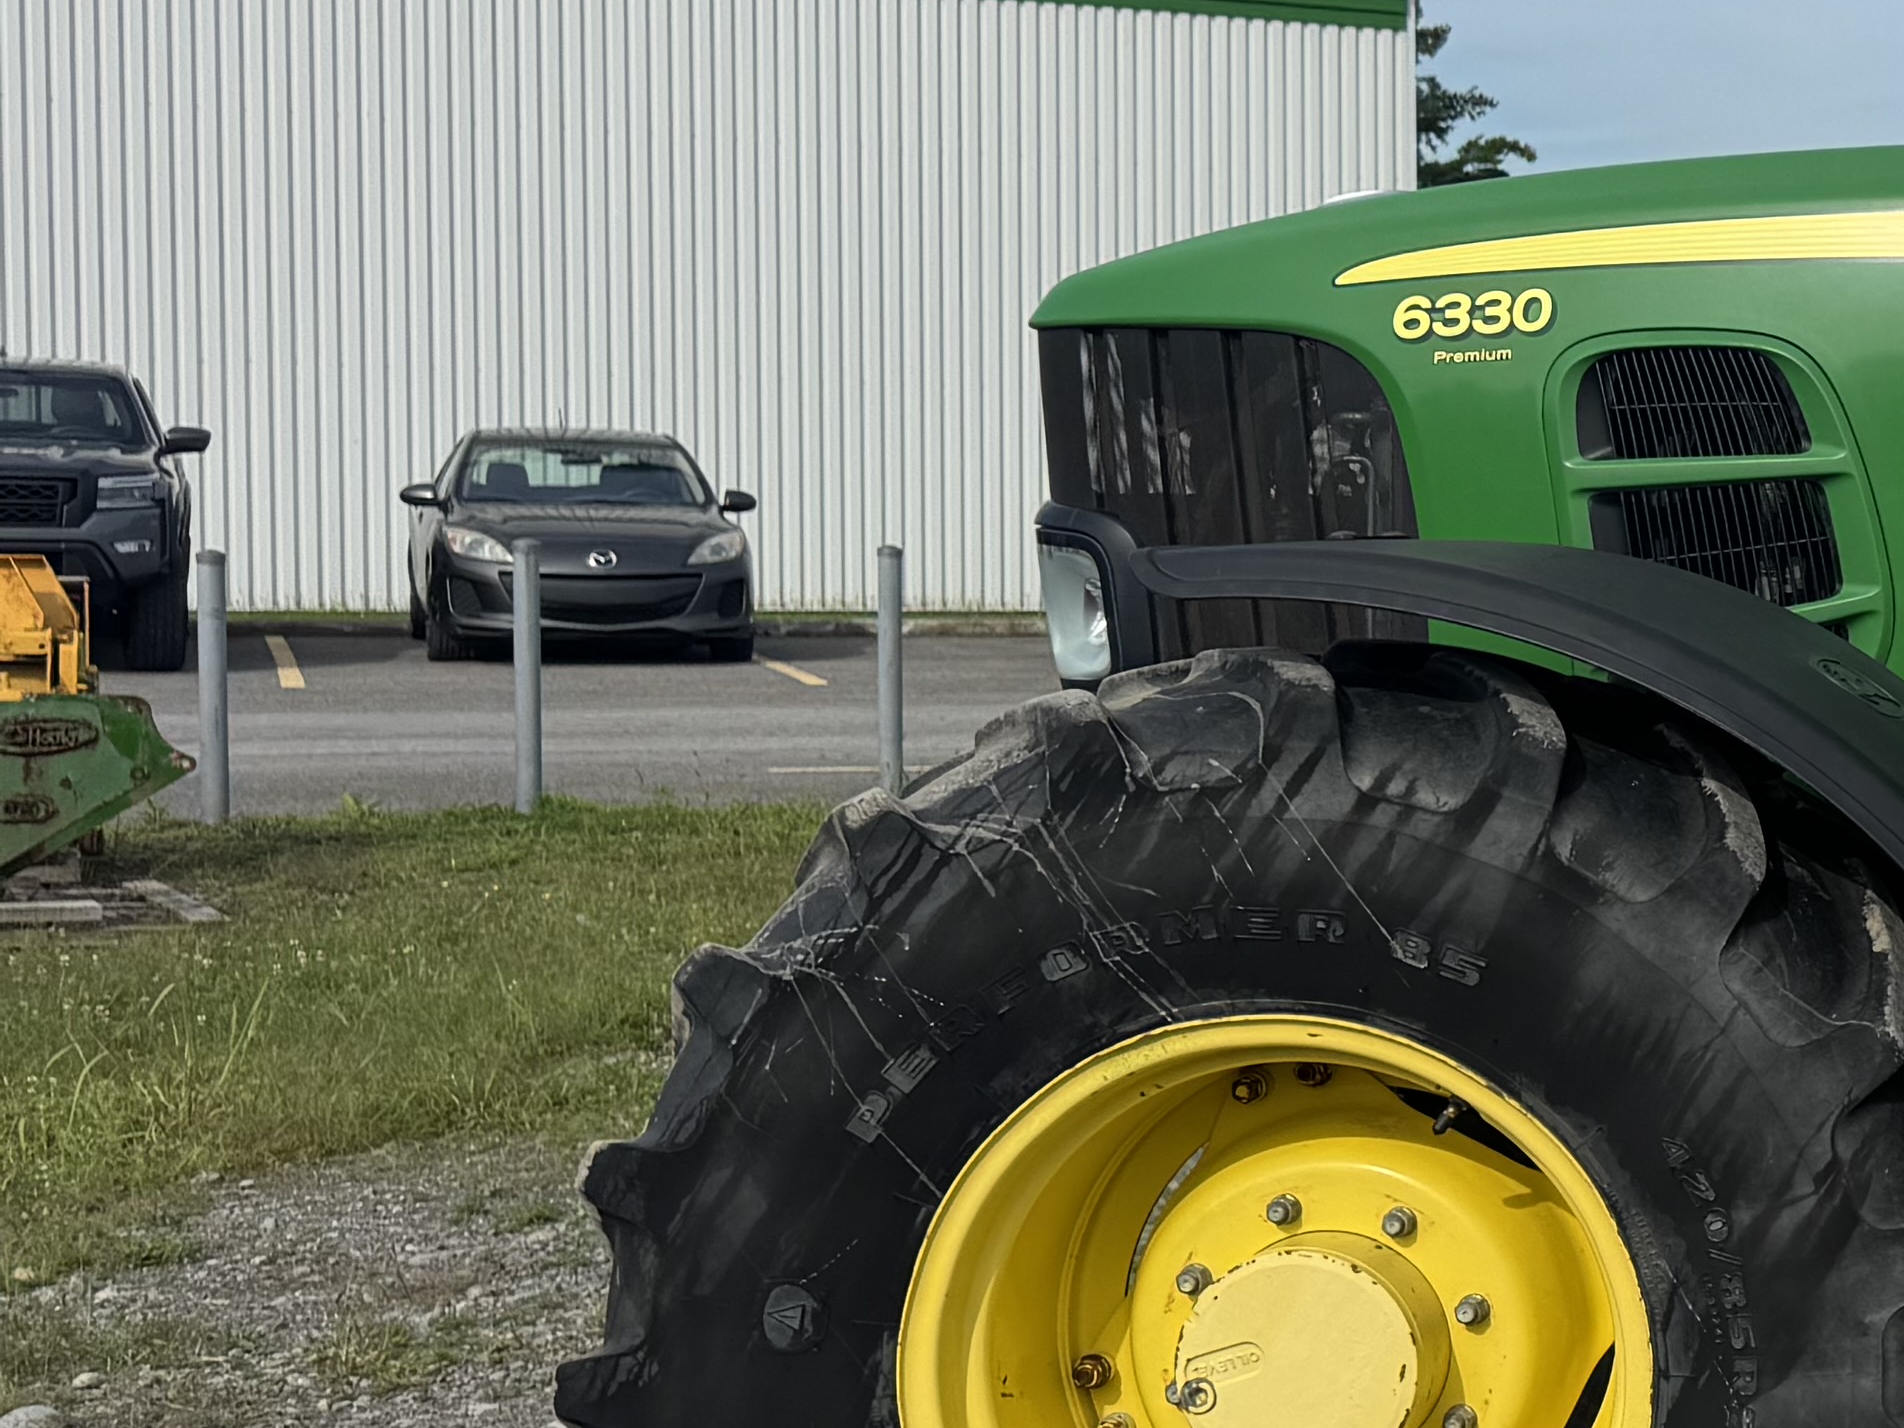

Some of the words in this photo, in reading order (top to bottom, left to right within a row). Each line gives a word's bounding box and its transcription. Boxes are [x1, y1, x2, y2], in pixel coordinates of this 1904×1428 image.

[1392, 287, 1553, 340] 6330
[1433, 348, 1512, 365] Premium
[845, 905, 1347, 1143] PERFORMER
[1392, 926, 1488, 987] 85
